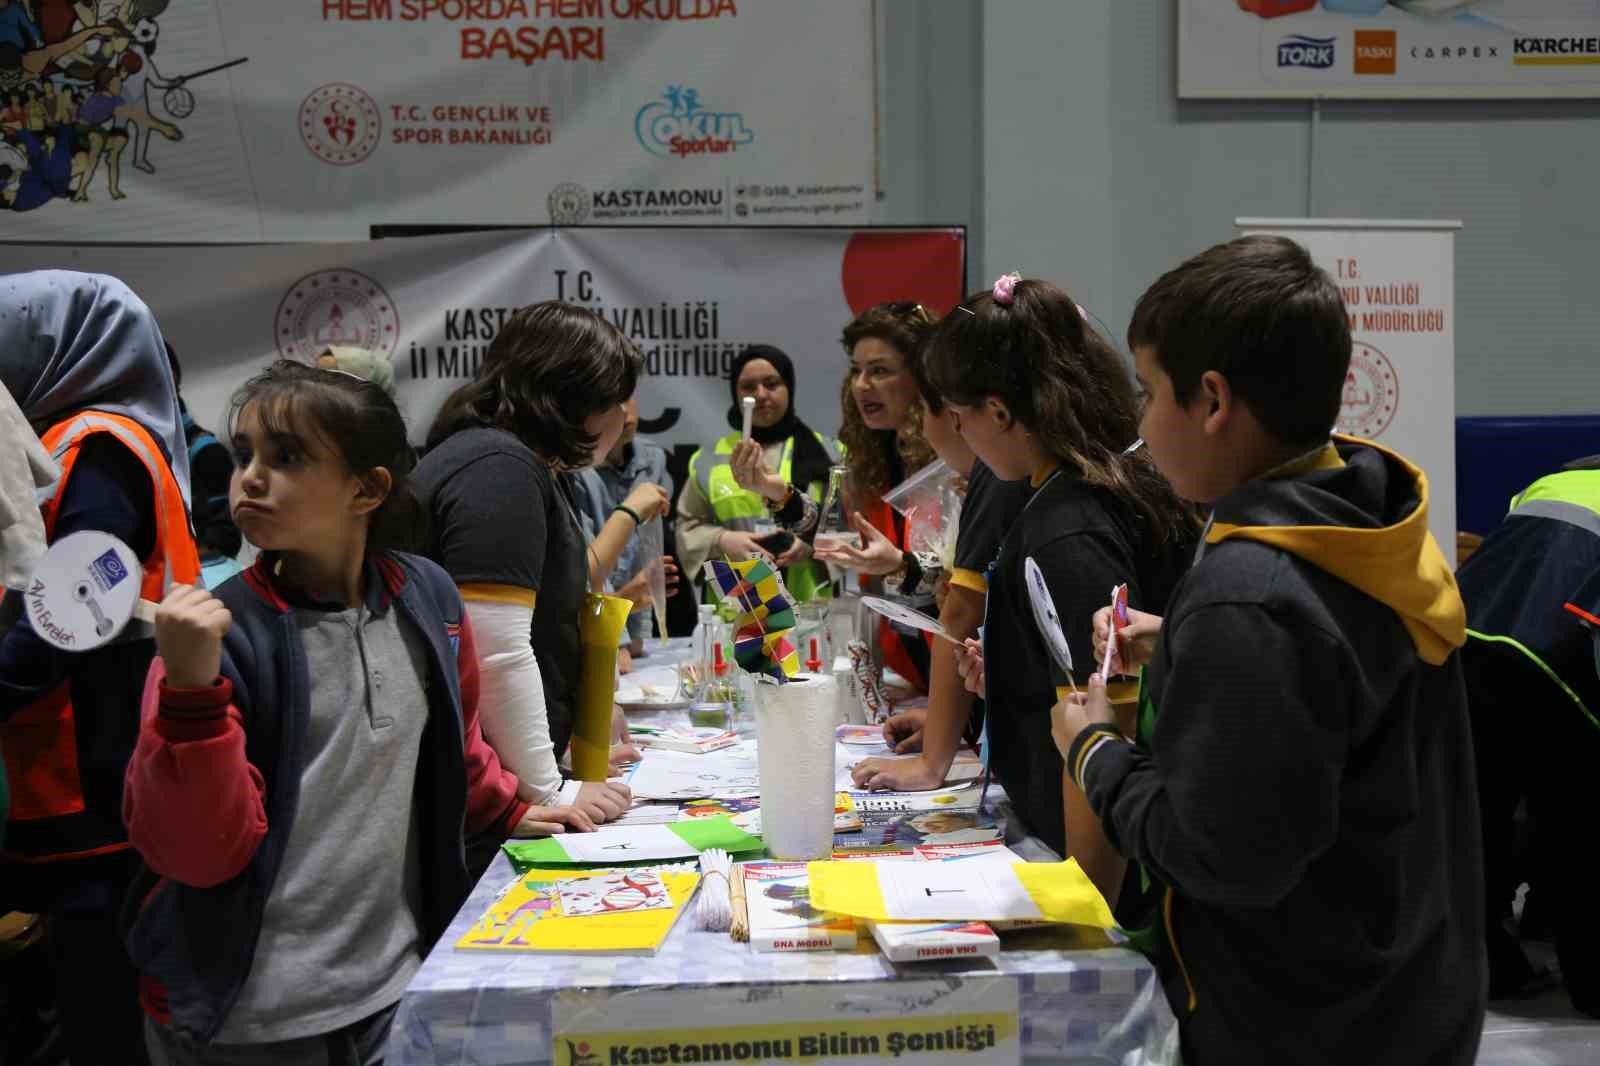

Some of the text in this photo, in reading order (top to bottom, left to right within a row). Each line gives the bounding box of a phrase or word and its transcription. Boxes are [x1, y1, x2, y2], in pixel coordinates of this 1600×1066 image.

[322, 0, 737, 21] HEM SPORDA HEM OKULDA
[460, 27, 606, 66] BAŞARI
[1357, 46, 1393, 59] TASKI
[1513, 36, 1600, 54] KÄRCHE
[1279, 46, 1333, 65] TORK
[391, 104, 551, 125] T.C. GENÇLİK VE
[392, 125, 552, 145] SPOR BAKANLIĞI
[650, 111, 754, 145] OKUL
[592, 189, 723, 208] KASTAMONU
[1336, 259, 1360, 279] T.C.
[554, 270, 601, 301] T.C.
[613, 302, 719, 339] VALİLİĞİ
[773, 940, 794, 948] DNA
[955, 945, 978, 955] DNA
[609, 1023, 996, 1066] Kastamonu Bilim Şenliği
